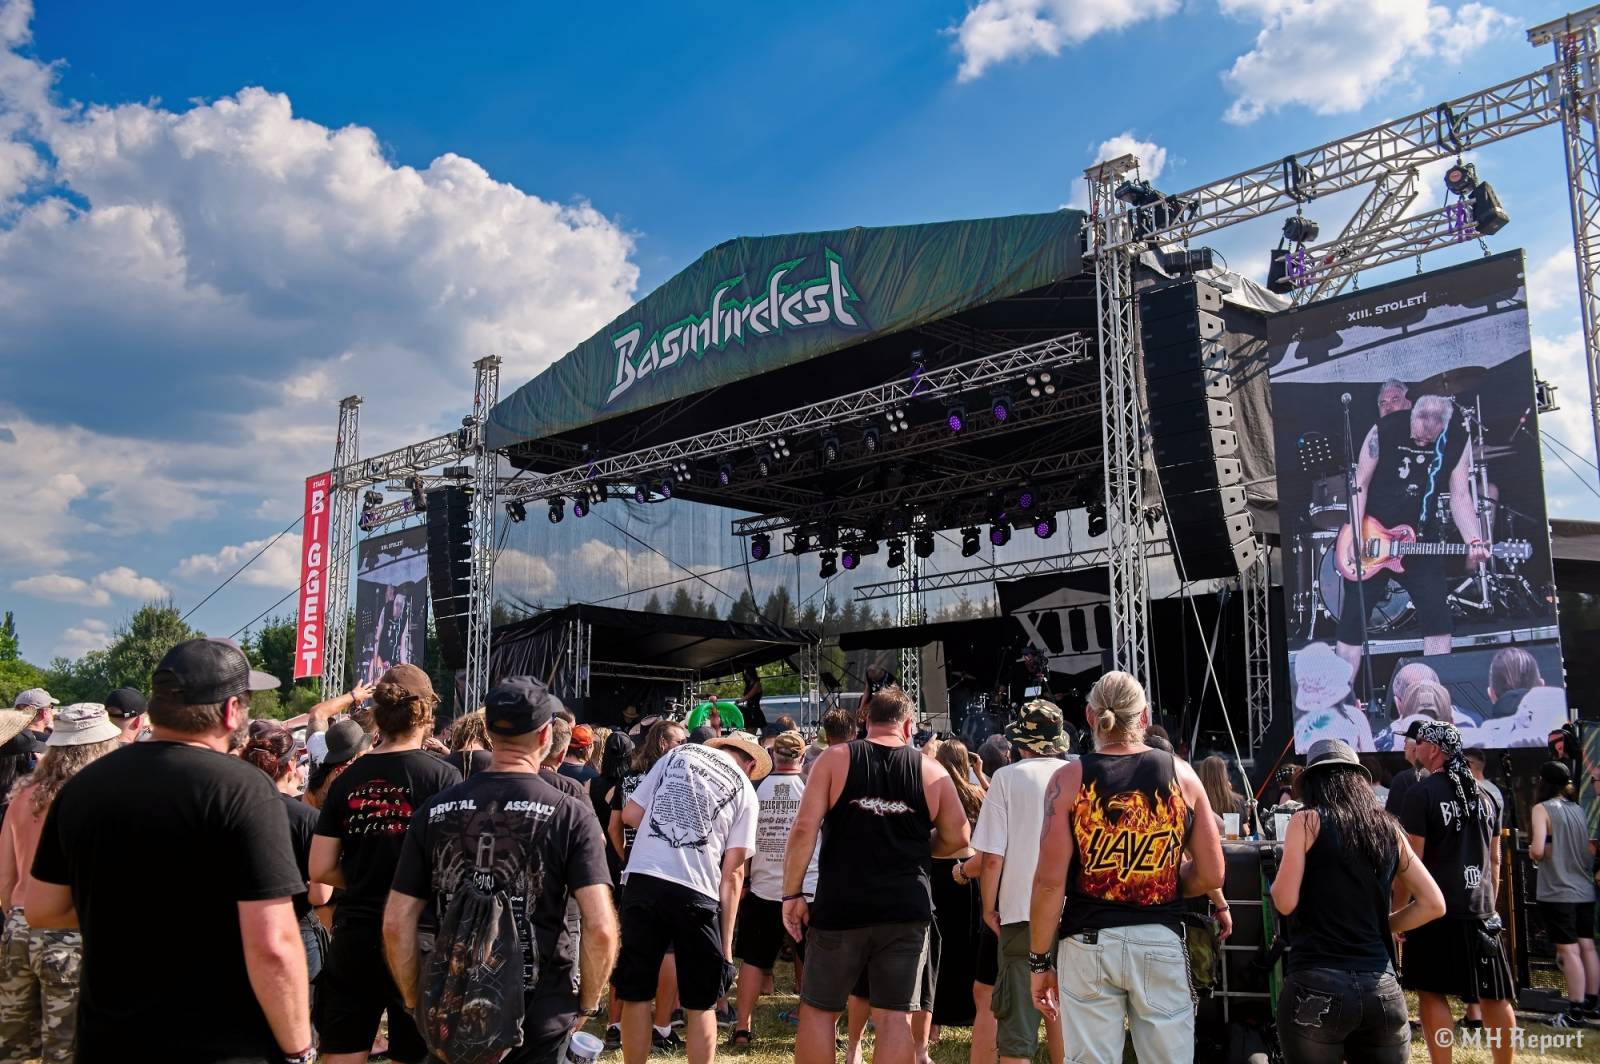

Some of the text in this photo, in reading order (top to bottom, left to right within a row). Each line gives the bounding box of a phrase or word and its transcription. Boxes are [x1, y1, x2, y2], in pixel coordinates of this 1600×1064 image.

[605, 254, 858, 404] Basinfirefest
[1347, 291, 1427, 322] XIII. STOLETÍ
[302, 490, 324, 677] BIGGEST
[429, 799, 555, 818] BRUTAL ASSAULT
[1085, 827, 1182, 882] SLAYER
